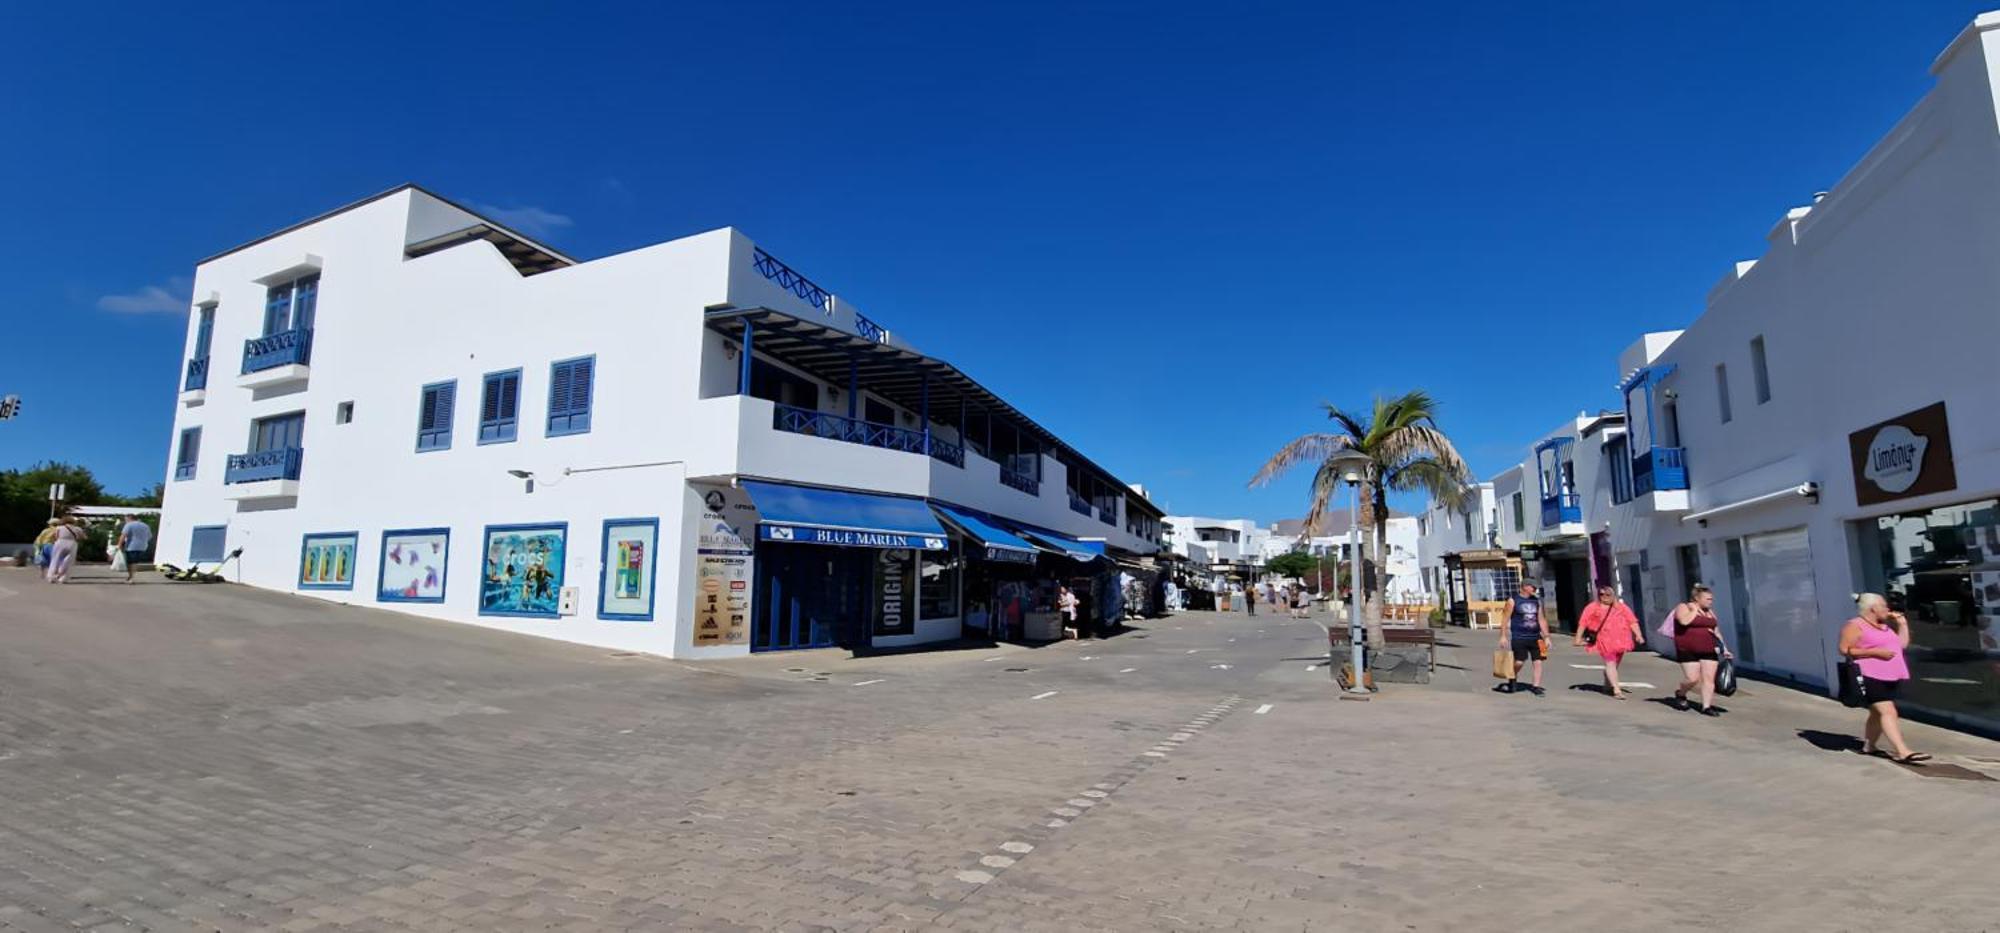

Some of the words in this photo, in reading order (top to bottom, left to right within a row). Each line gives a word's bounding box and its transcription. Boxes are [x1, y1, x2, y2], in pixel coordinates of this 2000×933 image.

[817, 530, 853, 543] BLUE
[855, 532, 907, 546] MARLIN
[503, 551, 544, 565] crocs
